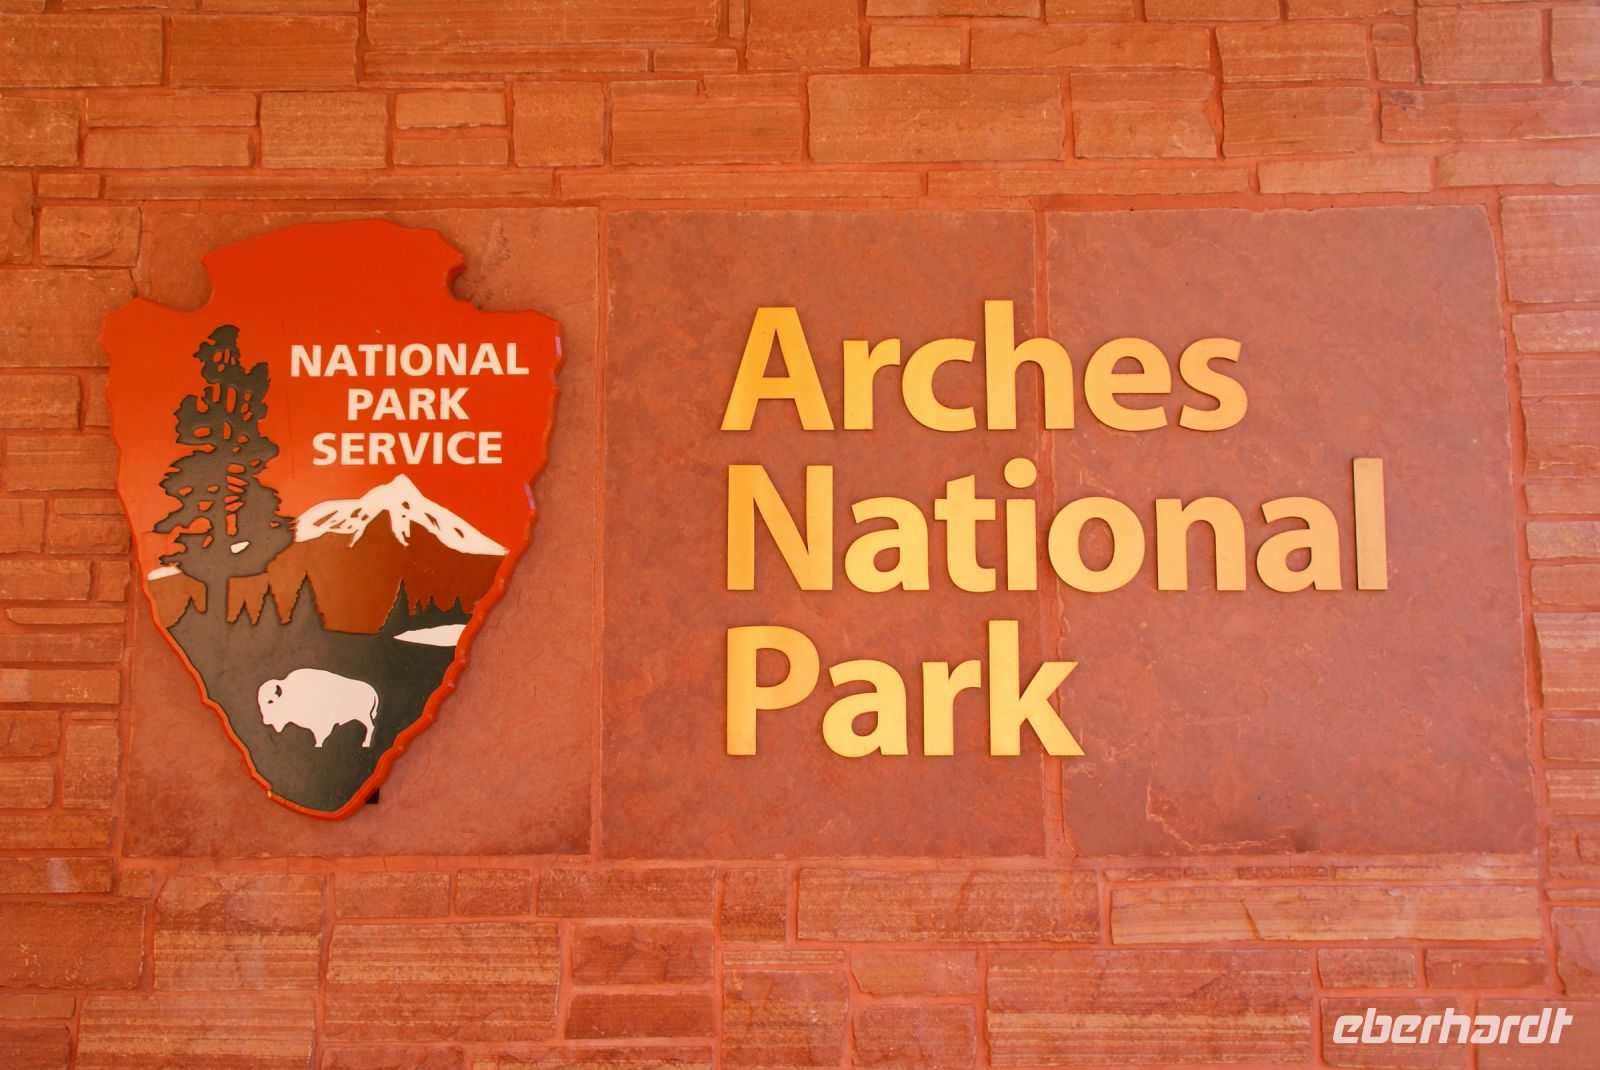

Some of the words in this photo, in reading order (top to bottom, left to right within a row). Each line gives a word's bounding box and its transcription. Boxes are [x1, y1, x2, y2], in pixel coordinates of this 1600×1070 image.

[291, 343, 529, 377] NATIONAL
[721, 299, 1248, 432] Arches
[348, 388, 469, 421] PARK
[313, 432, 502, 466] SERVICE
[728, 458, 1388, 592] National
[727, 620, 1085, 757] Park
